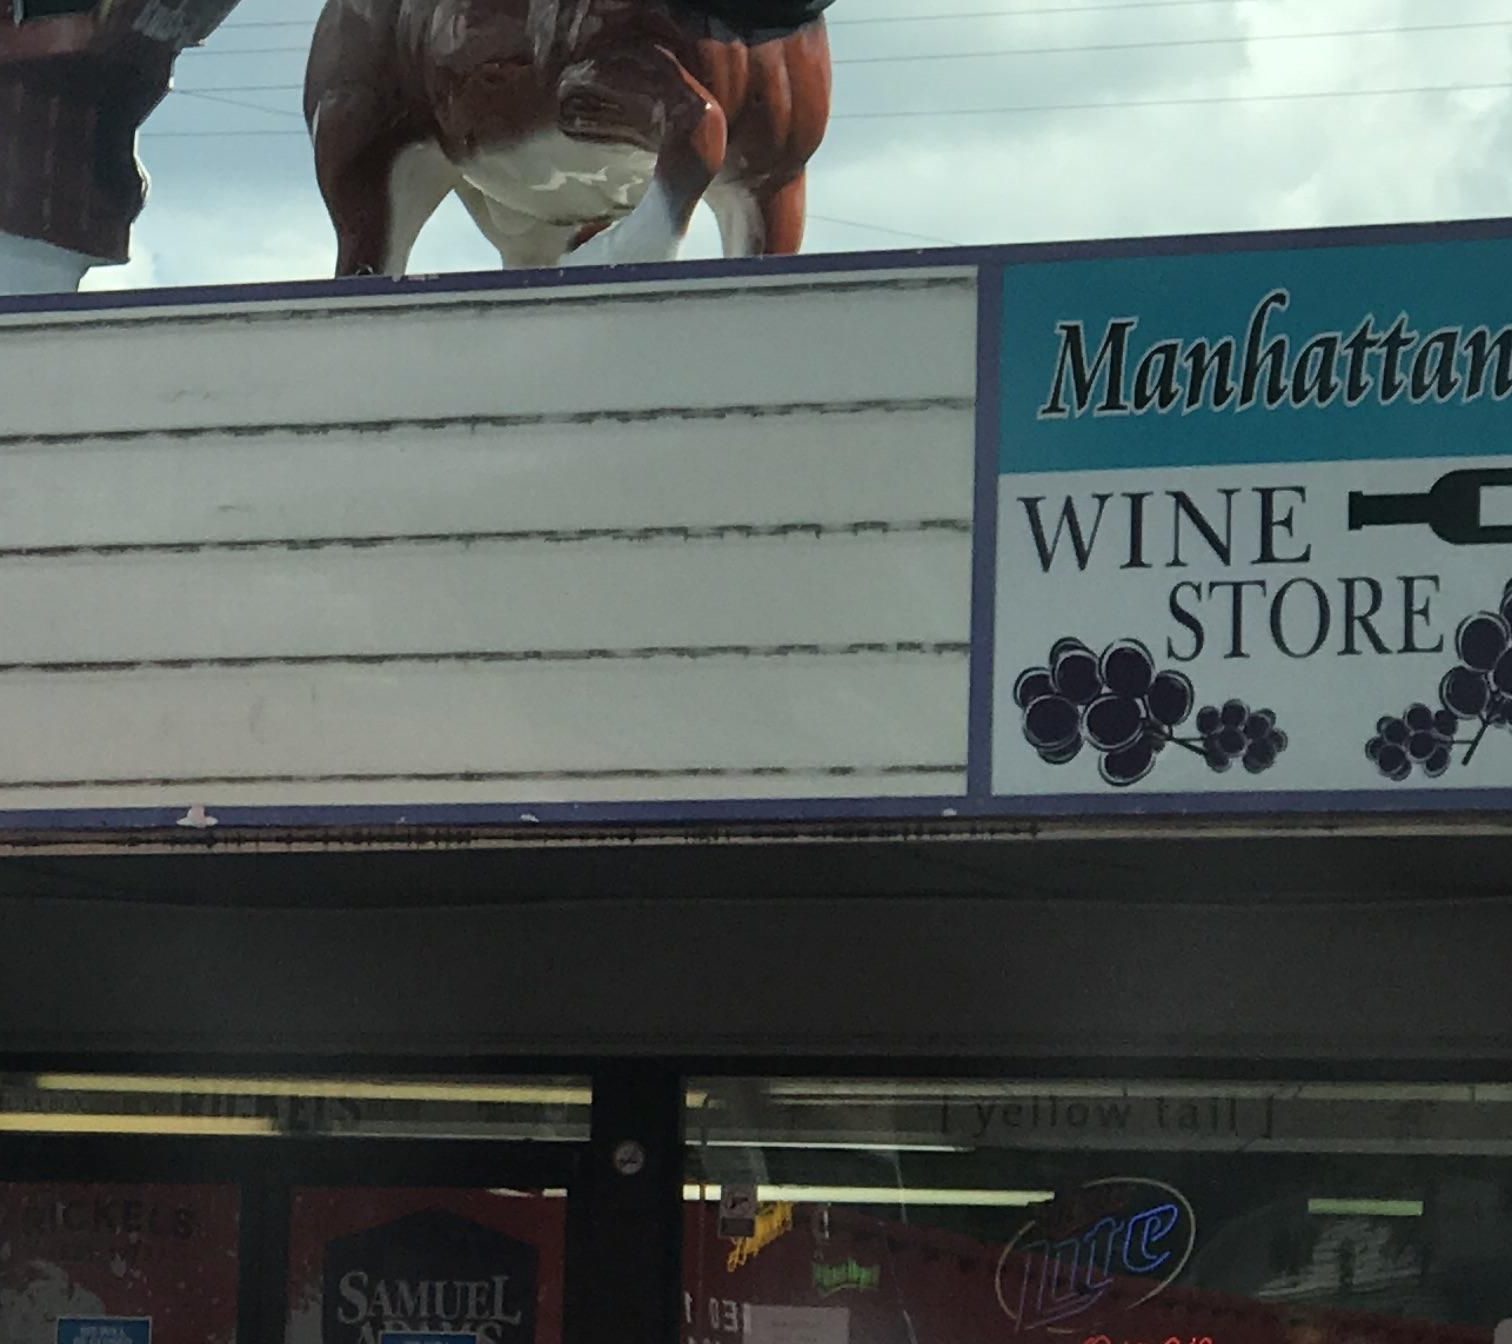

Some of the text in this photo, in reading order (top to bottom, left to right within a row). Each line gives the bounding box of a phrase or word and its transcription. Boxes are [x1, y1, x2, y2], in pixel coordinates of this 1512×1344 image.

[1038, 288, 1512, 420] Manhattan
[1016, 485, 1313, 573] WINE
[1166, 574, 1445, 662] STORE
[336, 1270, 523, 1326] SAMUEL
